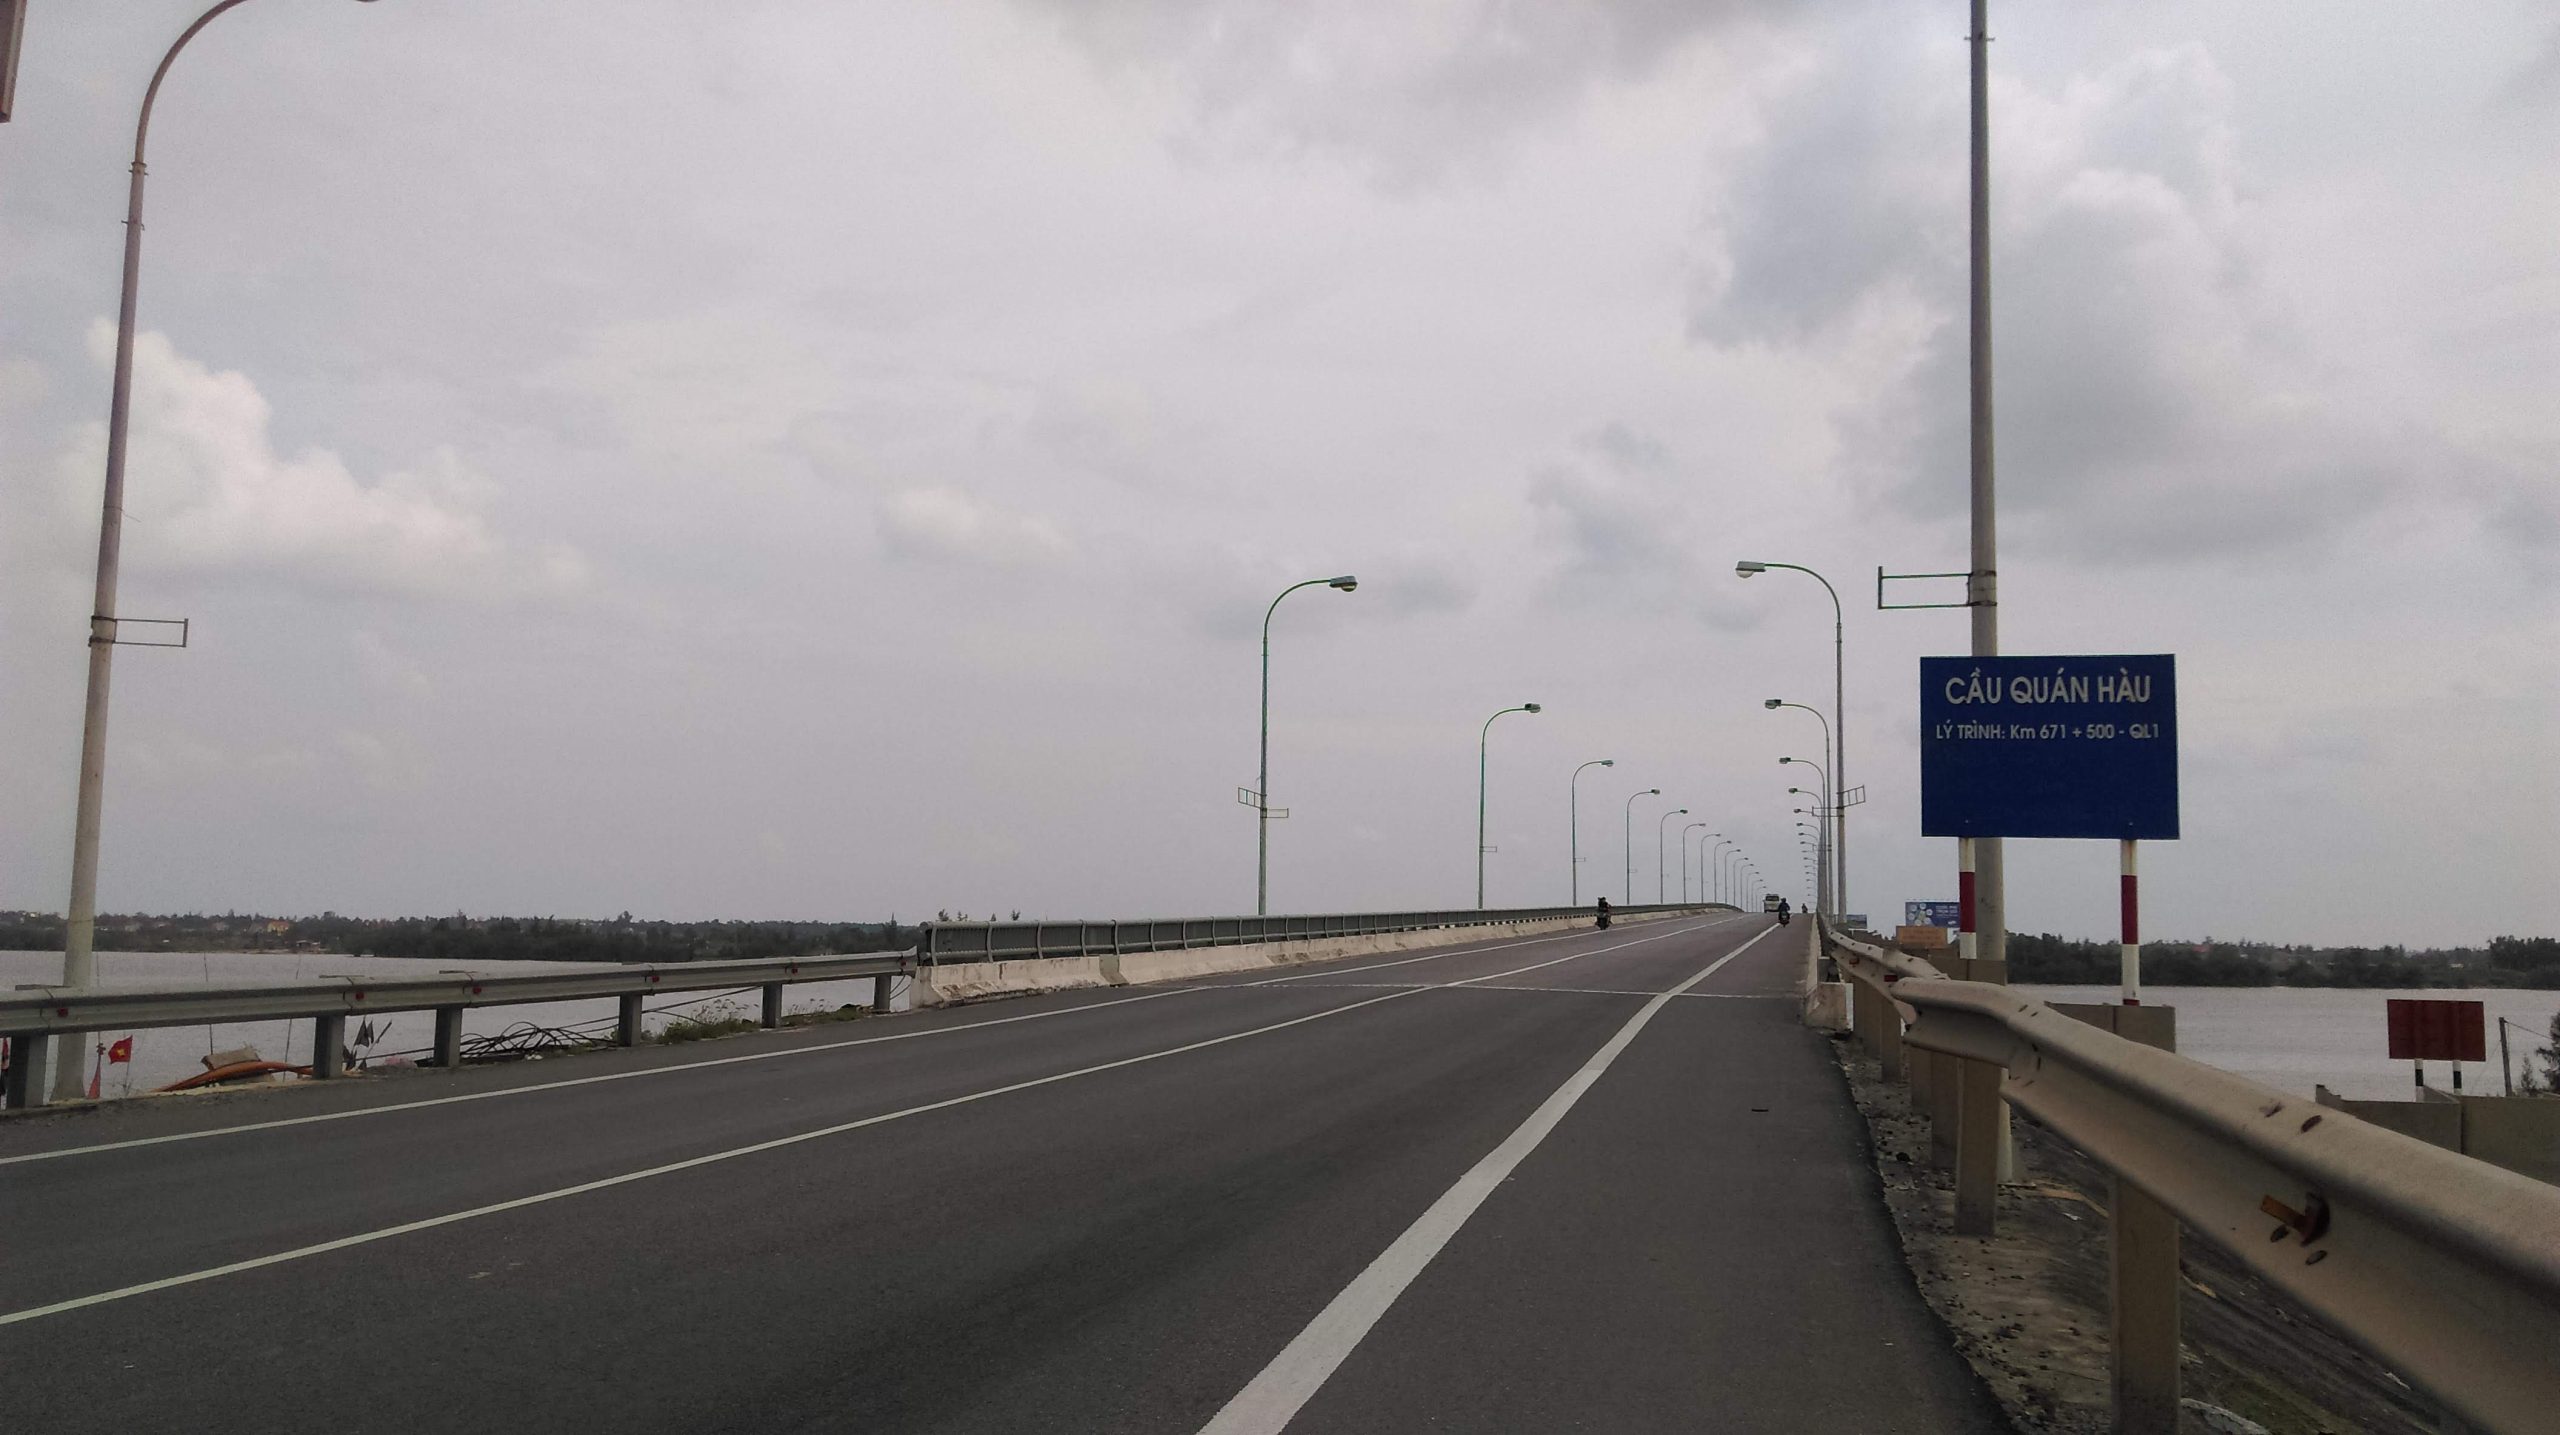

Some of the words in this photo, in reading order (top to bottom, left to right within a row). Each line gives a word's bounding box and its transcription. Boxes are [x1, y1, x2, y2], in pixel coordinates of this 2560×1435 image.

[1945, 667, 2002, 704] CẦU
[2010, 667, 2089, 704] QUÁN
[2098, 667, 2151, 703] HÀU
[1936, 719, 1953, 739] LÝ
[1957, 719, 2006, 739] TRÌNH:
[2010, 724, 2036, 739] Km
[2040, 724, 2066, 739] 671
[2072, 728, 2082, 738] +
[2086, 724, 2115, 739] 500
[2129, 723, 2160, 739] QL1
